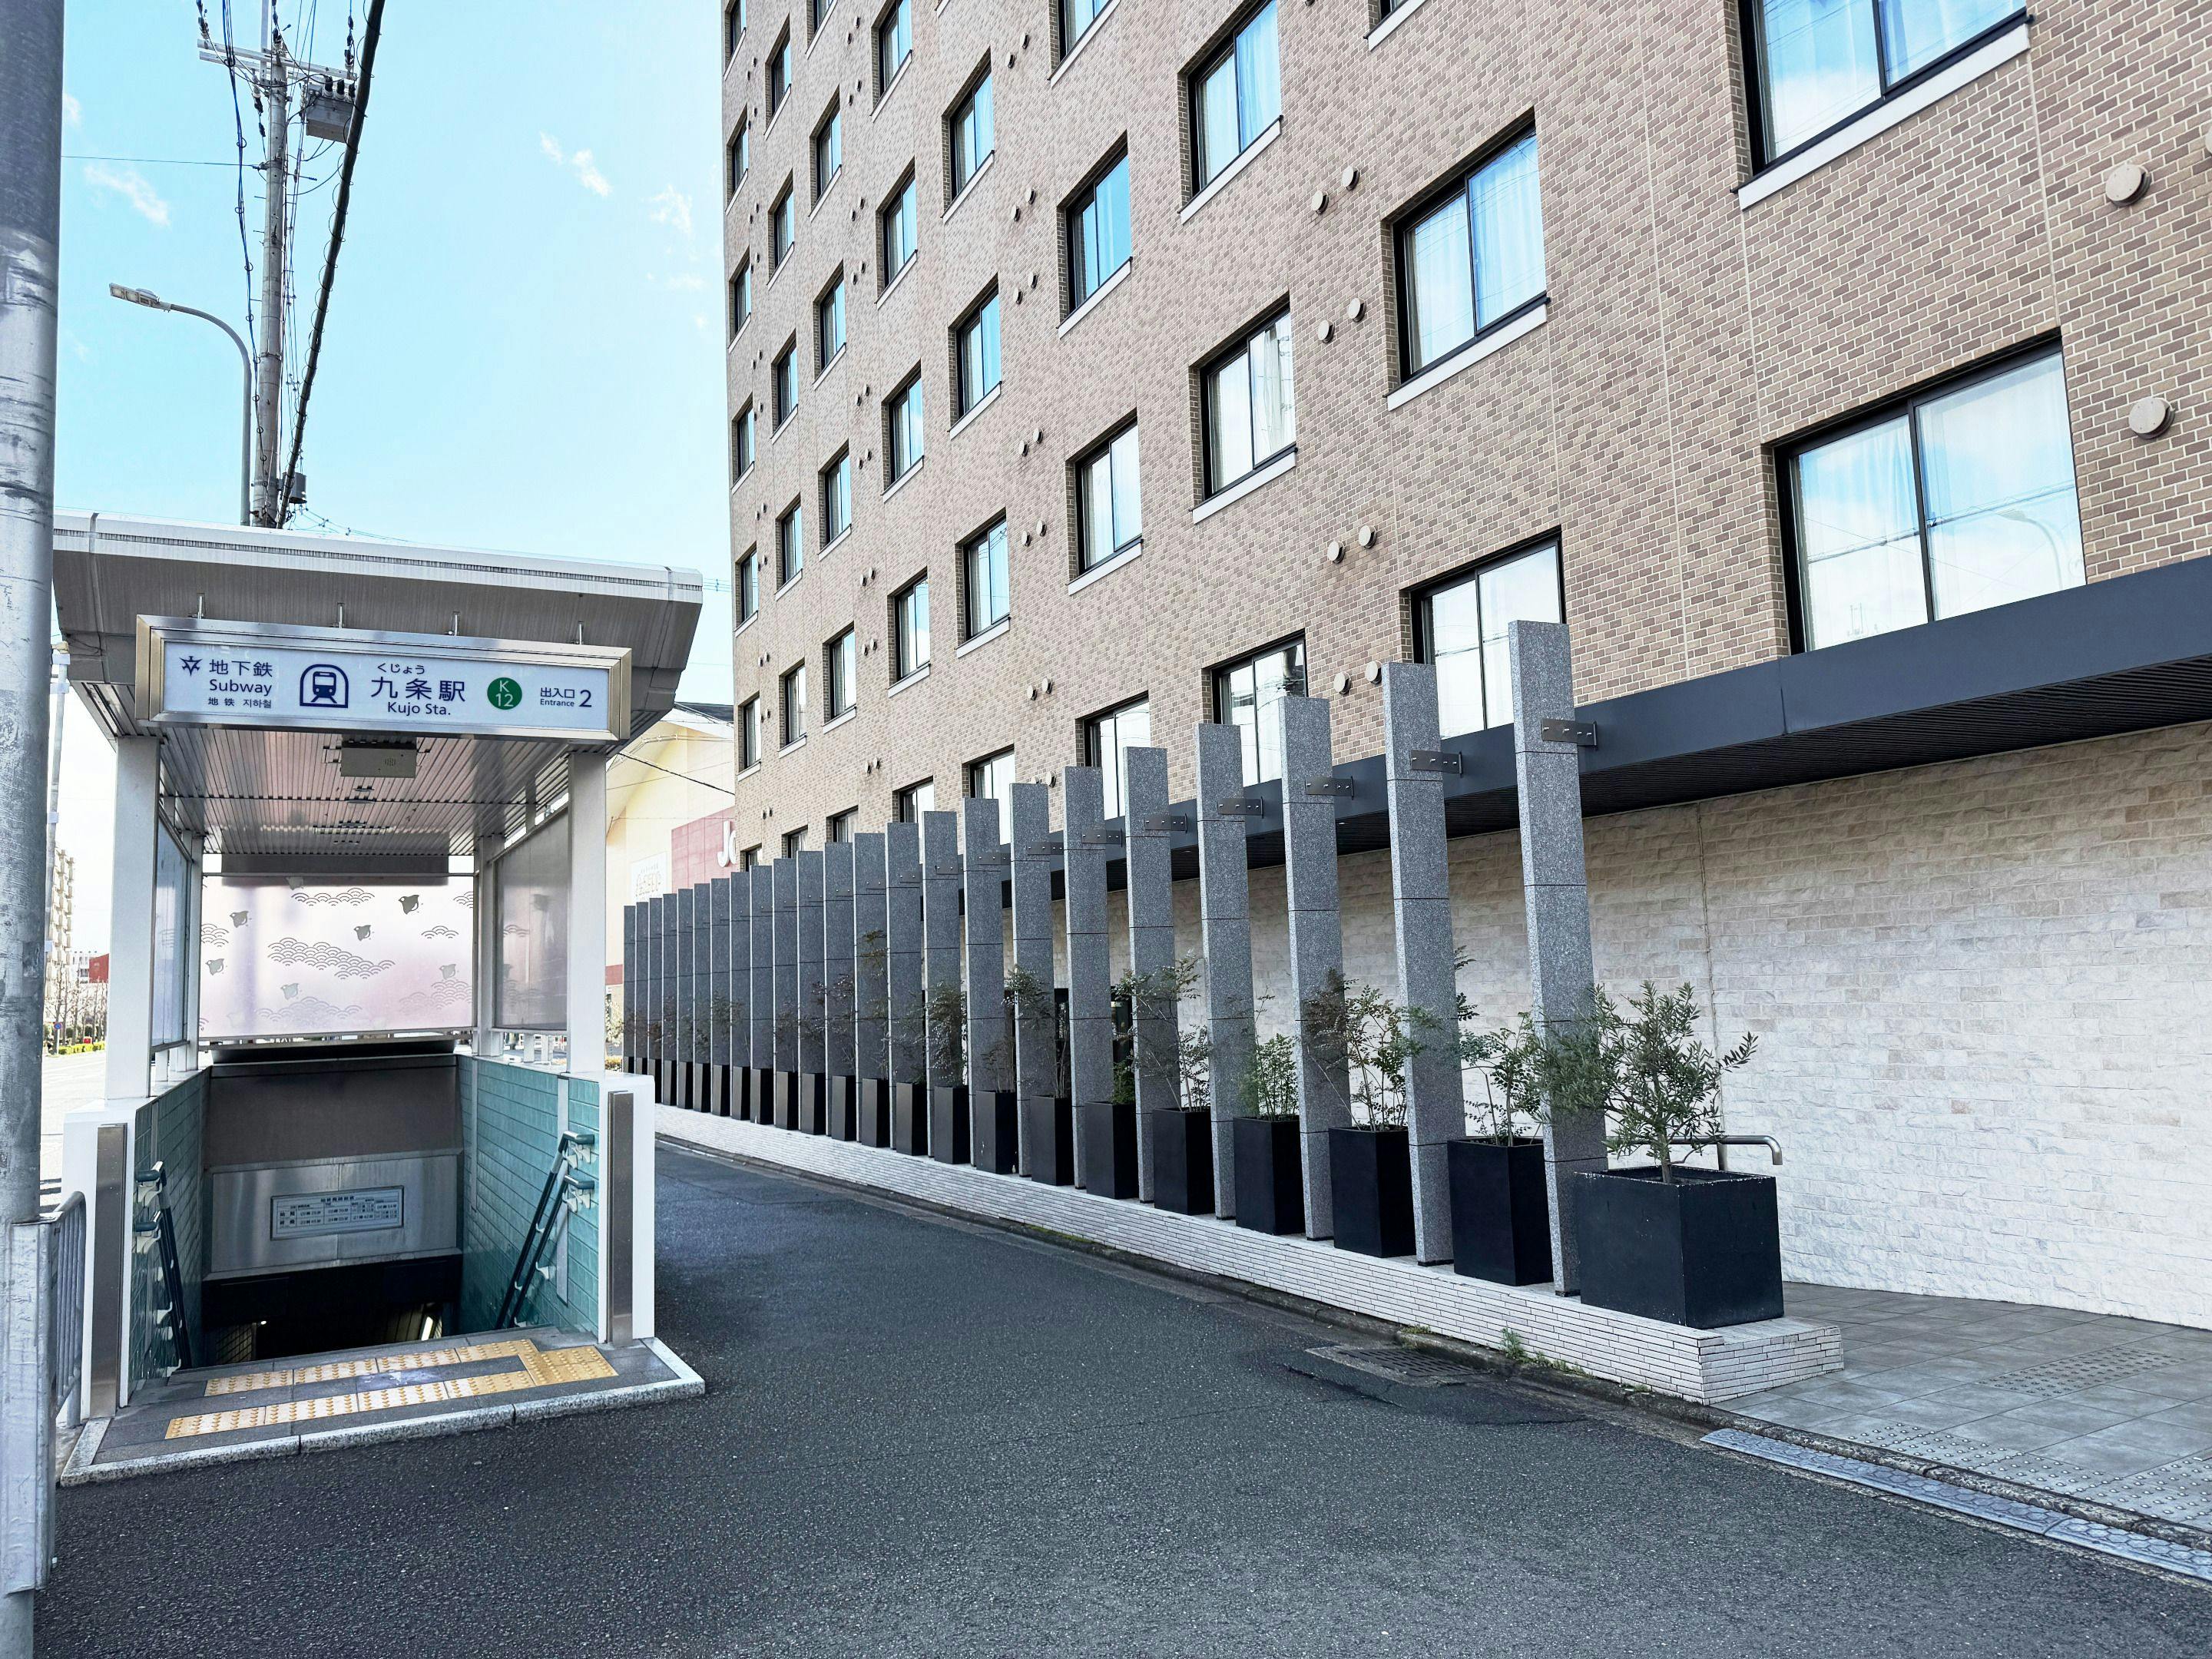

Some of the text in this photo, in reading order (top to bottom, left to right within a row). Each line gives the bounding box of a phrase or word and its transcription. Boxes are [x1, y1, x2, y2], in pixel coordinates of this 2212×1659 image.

[209, 659, 273, 677] 地下鉄
[376, 662, 426, 675] くじょう
[209, 679, 273, 697] Subway
[370, 676, 466, 702] 九条駅
[499, 680, 509, 693] K
[540, 687, 575, 699] 出入口
[243, 698, 272, 709] 지하철
[495, 693, 515, 707] 12
[540, 698, 575, 707] Entrance
[578, 689, 593, 707] 2
[387, 701, 452, 717] Kujo Sta.
